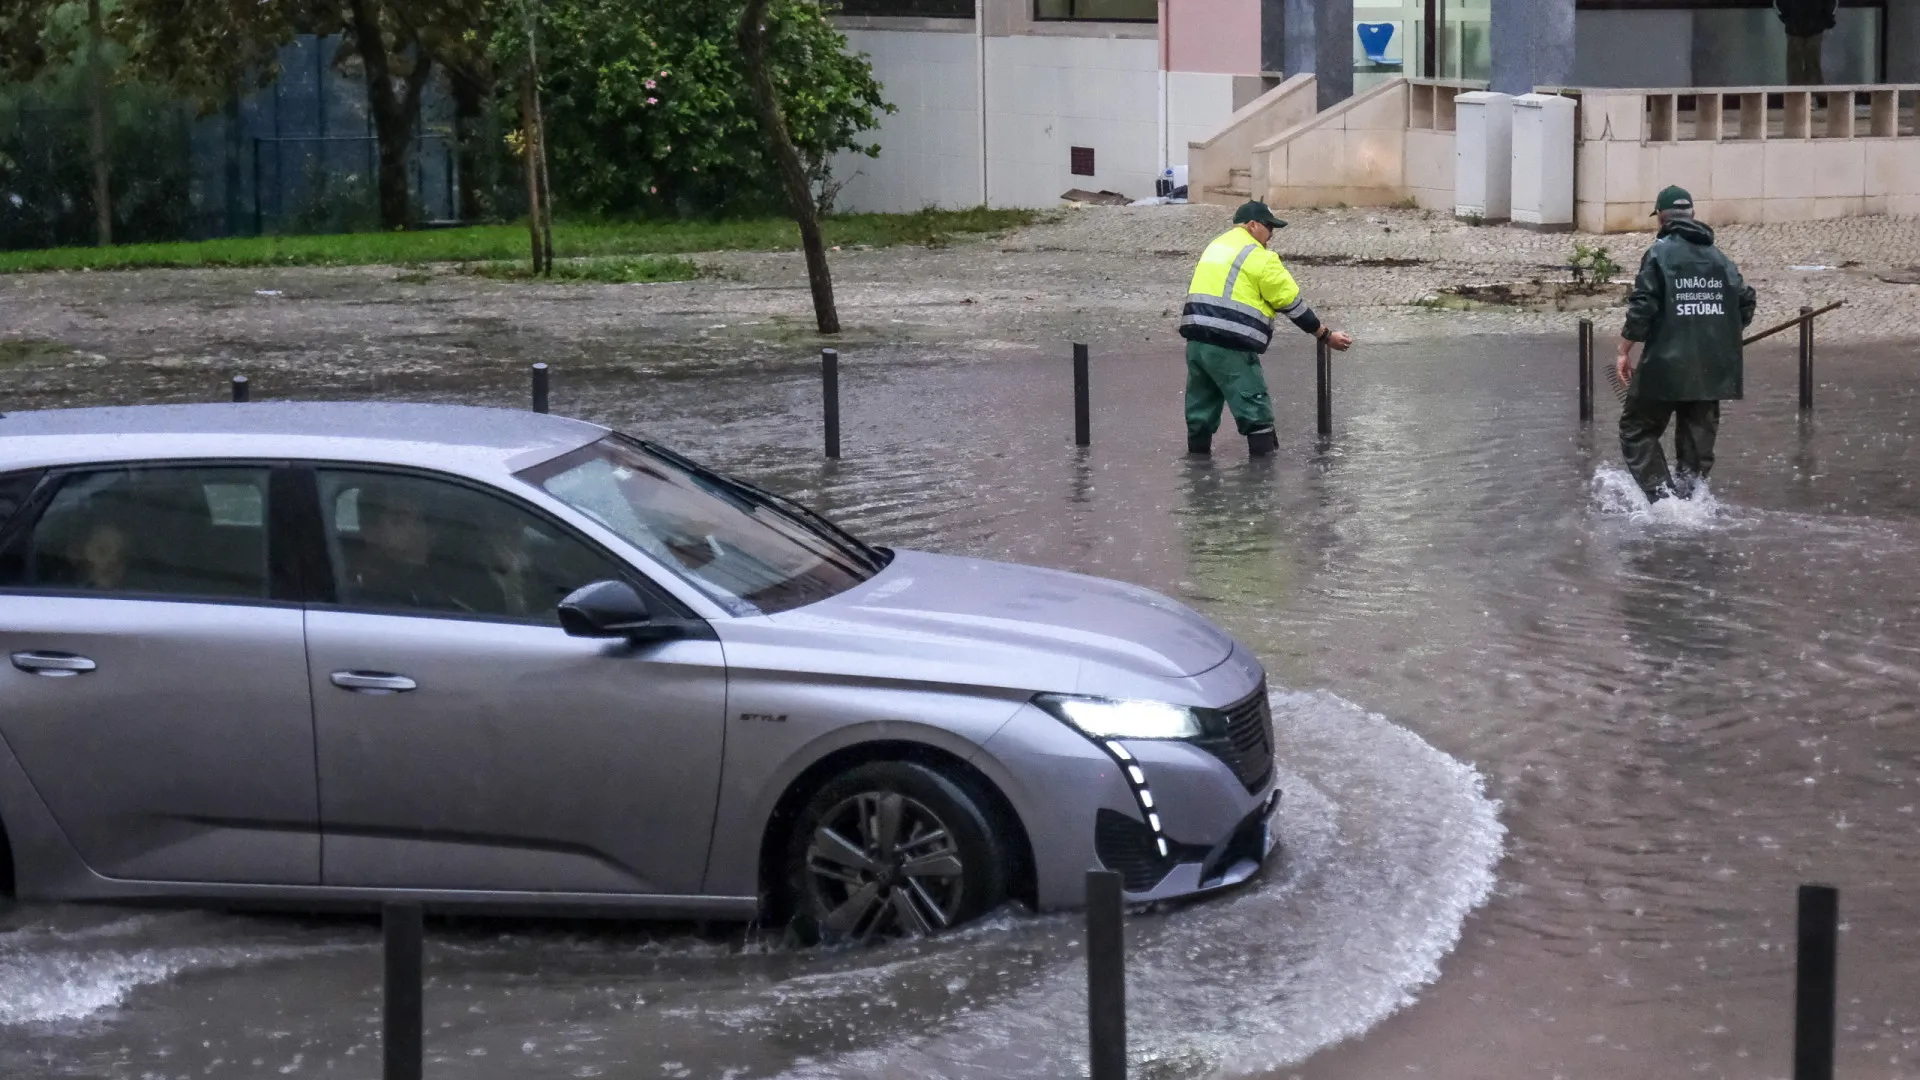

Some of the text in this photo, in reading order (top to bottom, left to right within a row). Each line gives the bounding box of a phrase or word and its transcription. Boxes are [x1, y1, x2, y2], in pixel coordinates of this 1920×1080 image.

[1675, 276, 1723, 289] UNIÃO das
[1676, 292, 1723, 301] FREGUESIAS de
[1676, 301, 1725, 316] SETÚBAL
